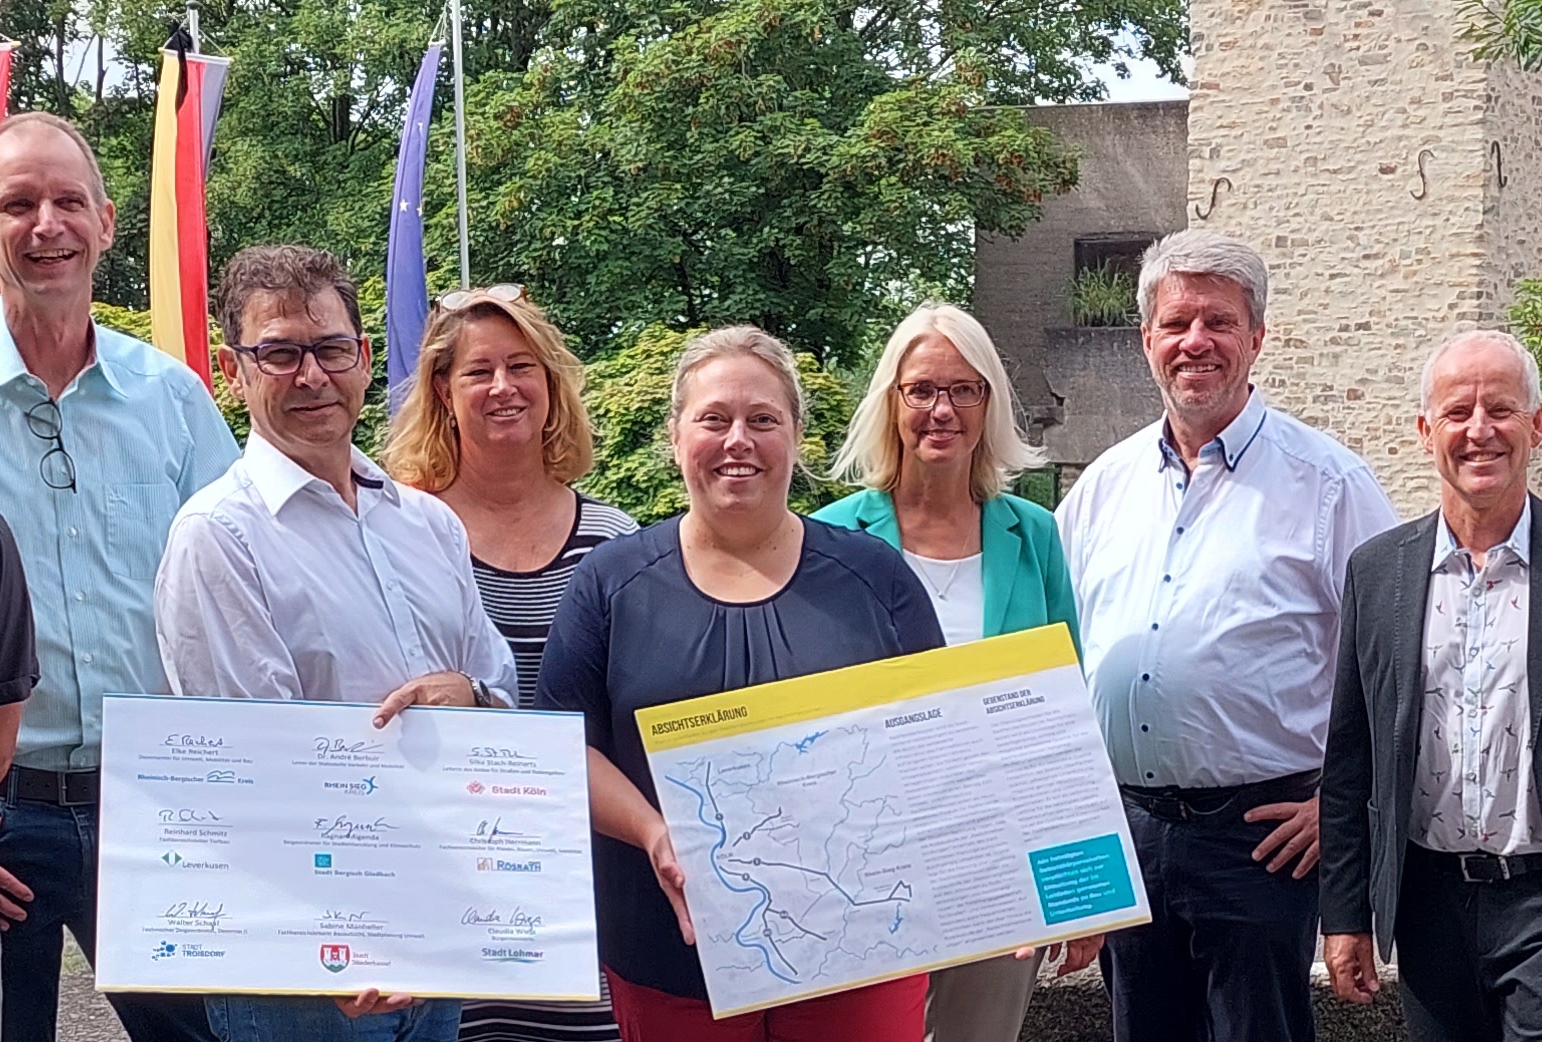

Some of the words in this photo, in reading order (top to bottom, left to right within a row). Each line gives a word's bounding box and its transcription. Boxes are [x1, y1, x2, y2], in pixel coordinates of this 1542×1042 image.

[983, 691, 1019, 705] GEGENSTAND
[1020, 689, 1032, 698] DER
[651, 706, 748, 736] ABSICHTSERKLÄRUNG
[885, 708, 943, 728] AUSGANGSLAGE
[492, 786, 521, 795] Stadt
[523, 786, 547, 796] Köln
[164, 828, 197, 836] Reinhard
[199, 829, 228, 837] Schmitz
[182, 861, 229, 870] Leverkusen
[482, 948, 507, 957] Stadt
[508, 949, 544, 958] Lohmar
